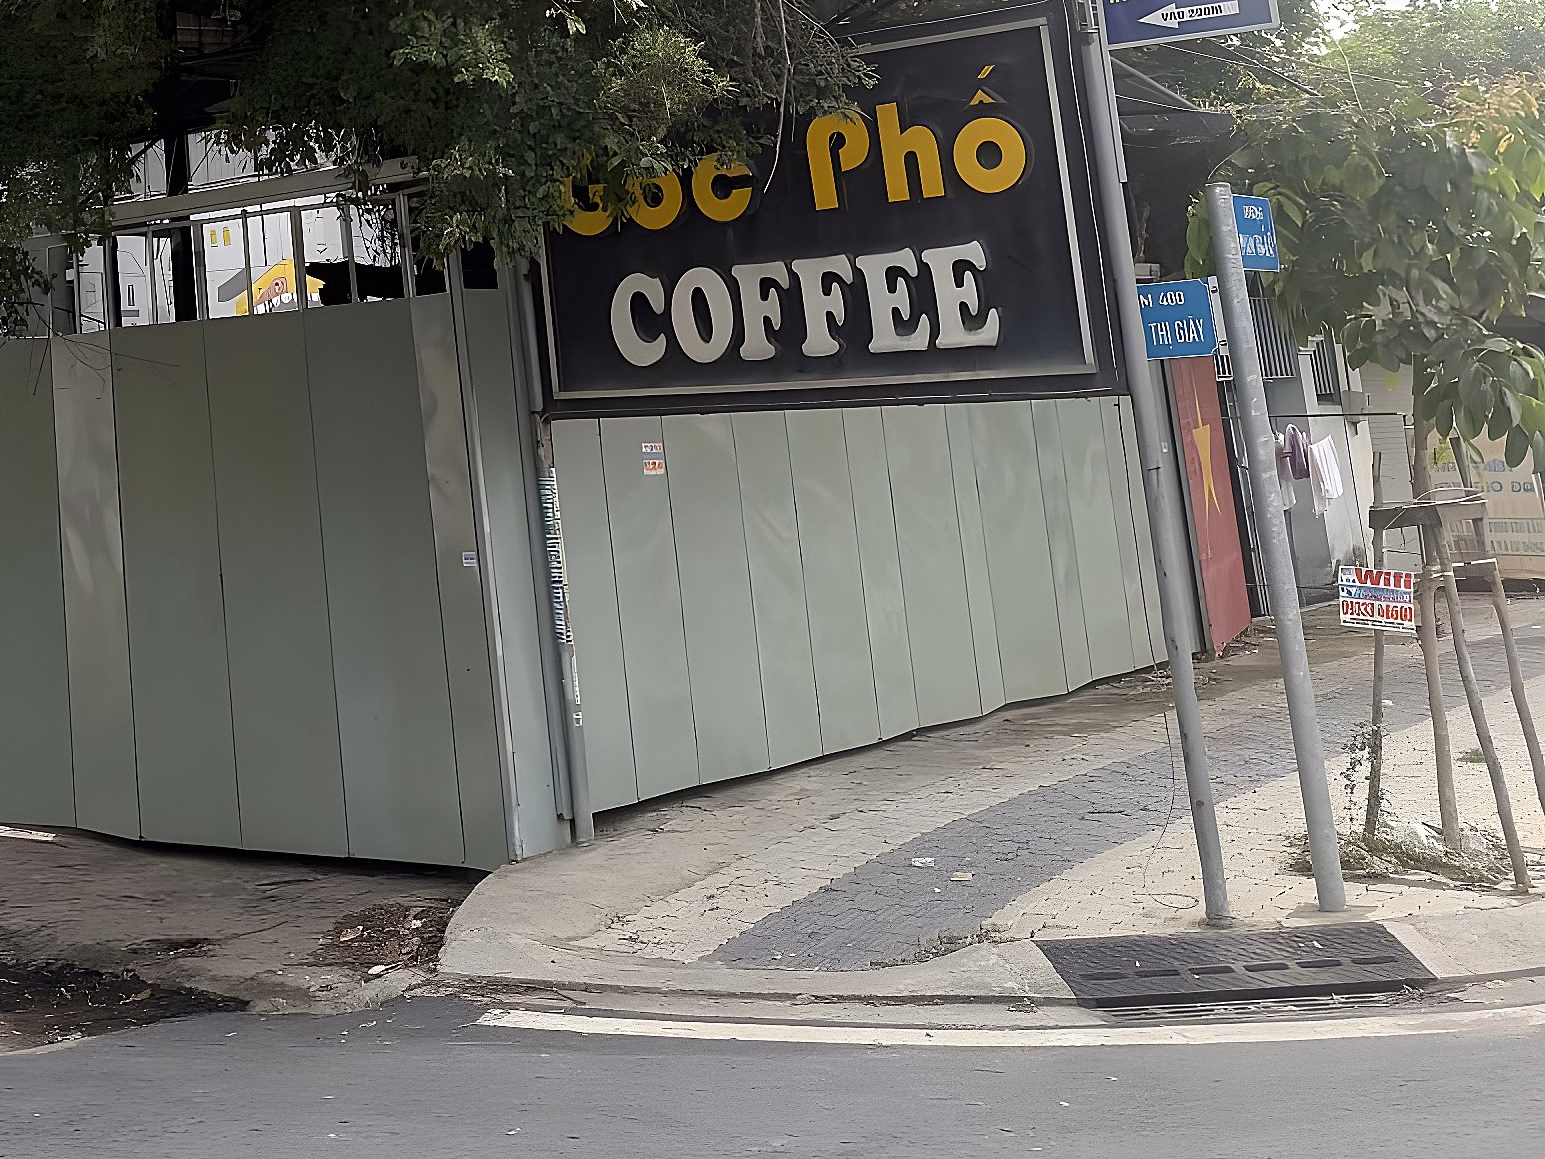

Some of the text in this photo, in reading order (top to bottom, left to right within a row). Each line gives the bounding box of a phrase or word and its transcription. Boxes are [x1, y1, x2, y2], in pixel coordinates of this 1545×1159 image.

[806, 64, 1026, 211] Phố
[610, 240, 1000, 367] COFFEE
[1148, 321, 1173, 350] THỊ
[1158, 291, 1185, 306] 400
